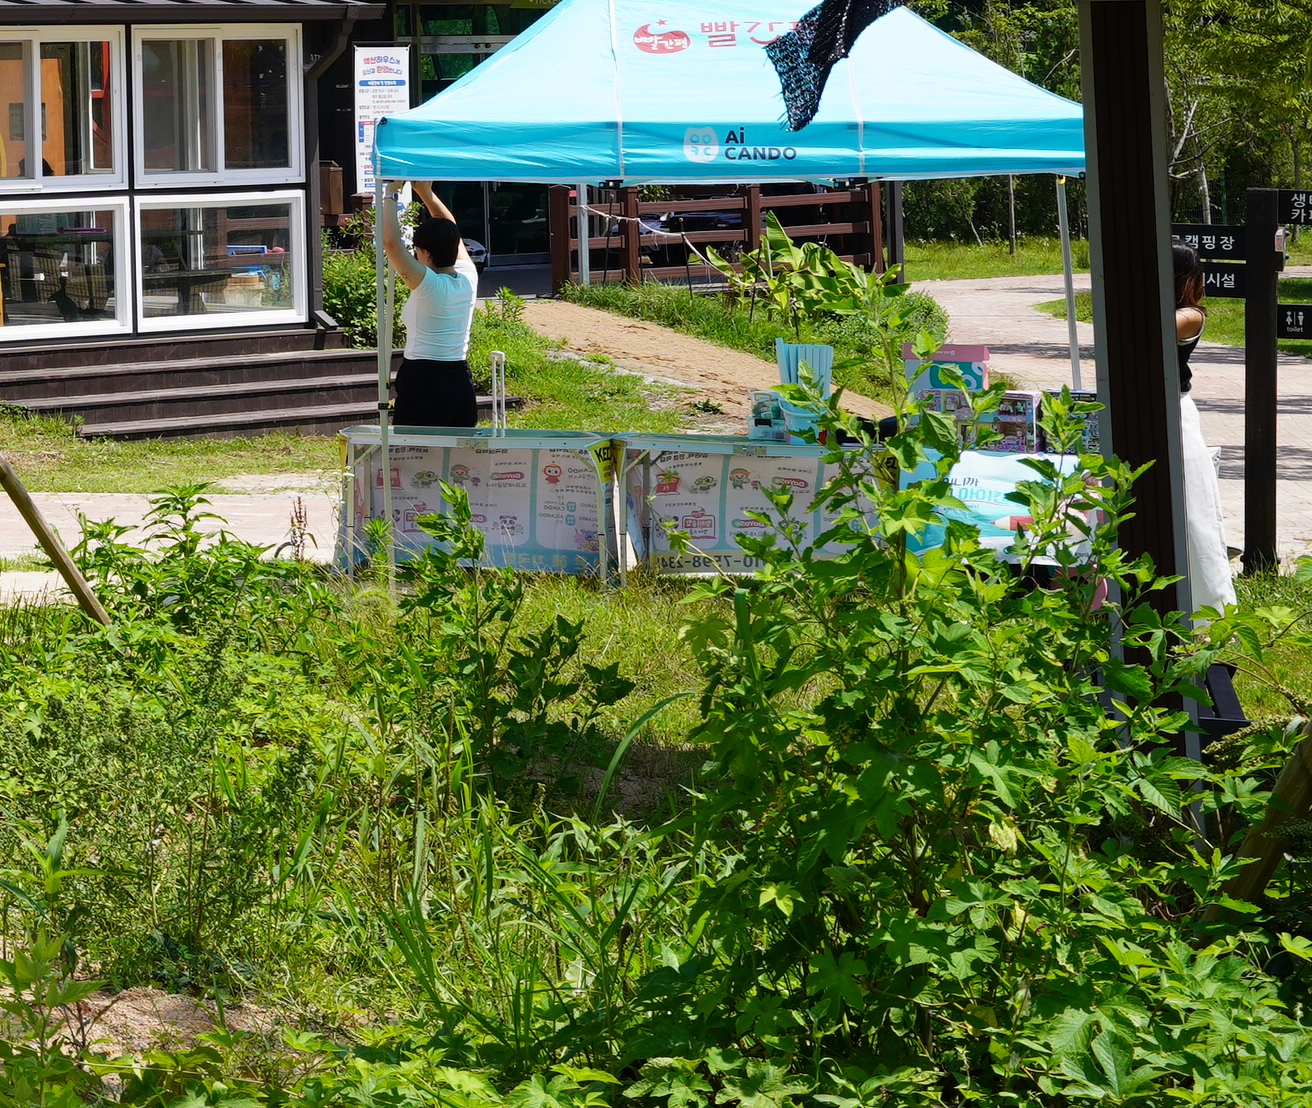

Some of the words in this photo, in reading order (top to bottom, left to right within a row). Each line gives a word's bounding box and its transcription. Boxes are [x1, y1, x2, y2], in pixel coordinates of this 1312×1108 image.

[634, 35, 688, 50] 빨간펜
[724, 126, 745, 144] Ai
[724, 146, 797, 161] CANDO
[1172, 235, 1236, 250] 캠핑장
[1202, 272, 1236, 289] 시설
